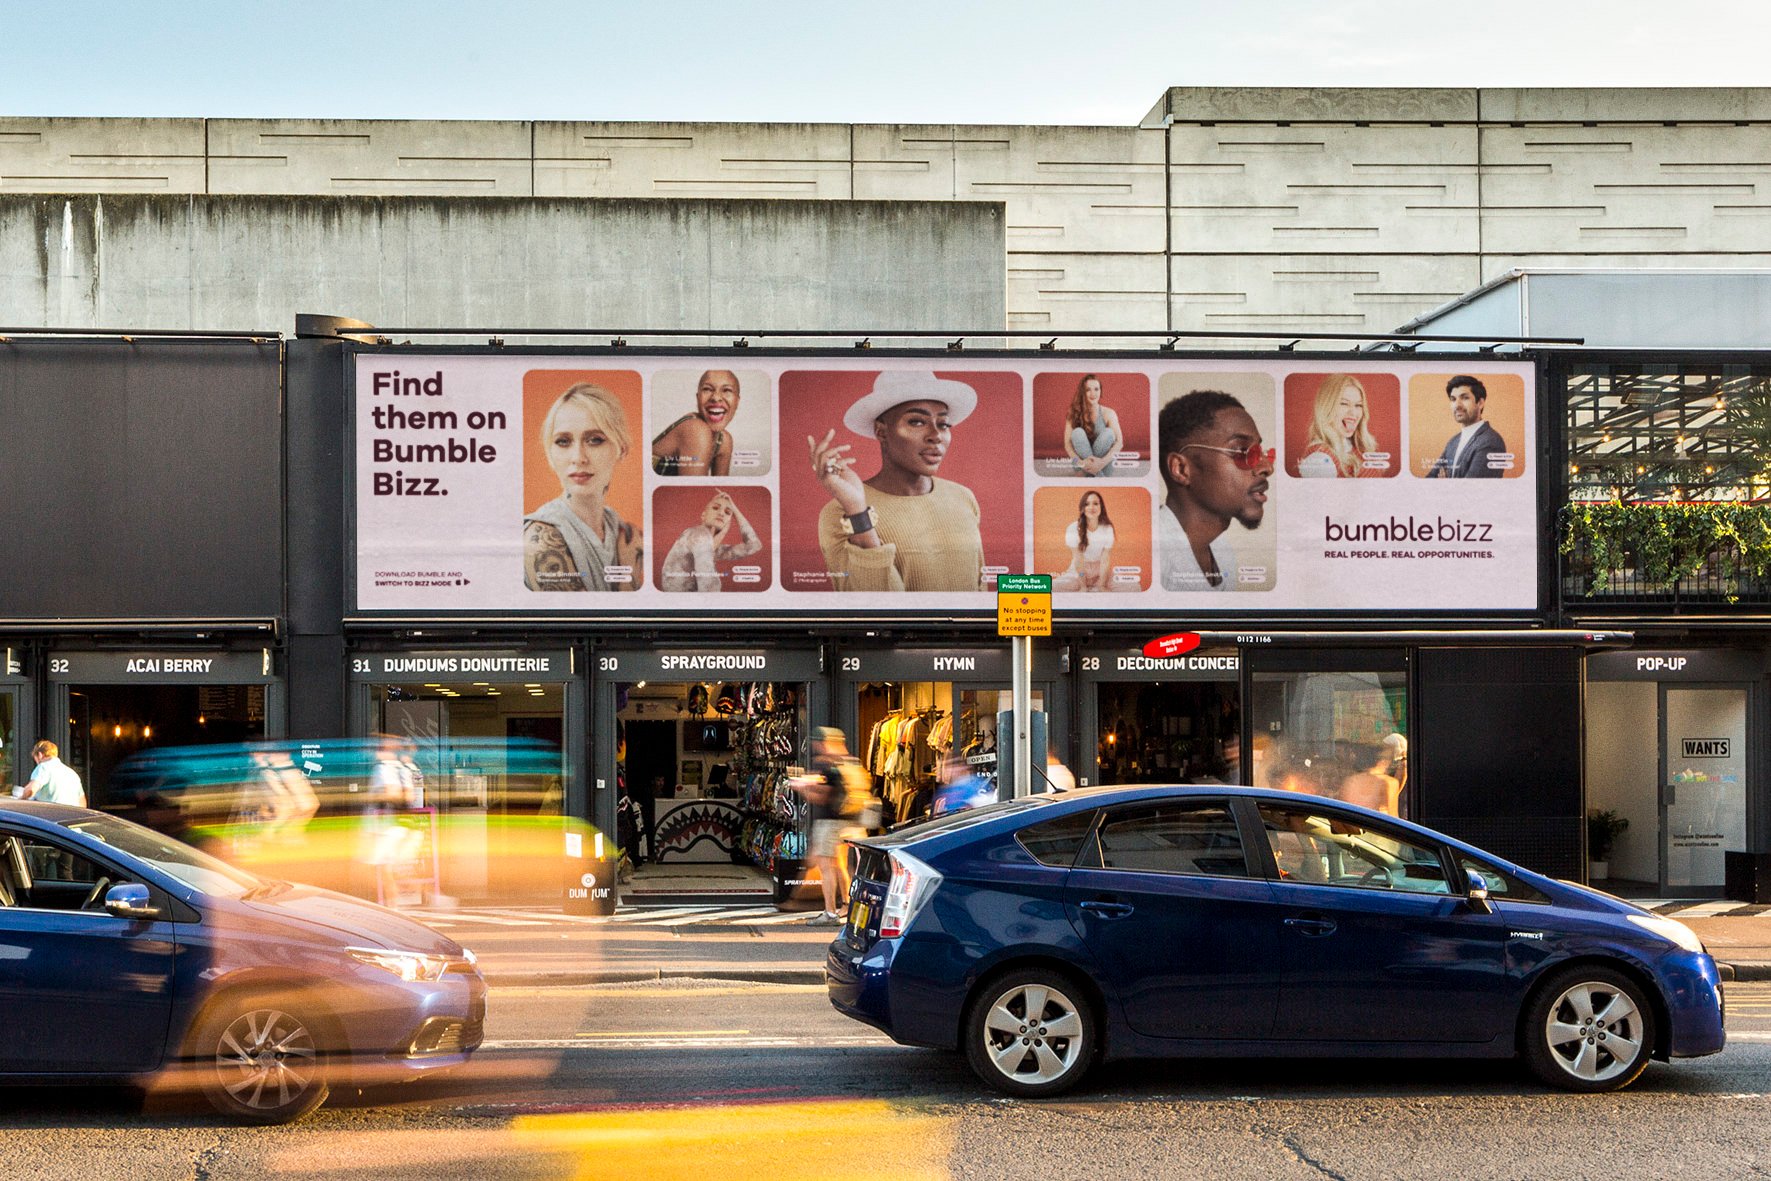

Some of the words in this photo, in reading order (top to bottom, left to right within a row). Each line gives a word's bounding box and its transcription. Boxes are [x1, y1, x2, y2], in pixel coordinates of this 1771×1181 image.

[373, 370, 443, 396] Find
[371, 404, 458, 430] them
[467, 411, 507, 430] on
[373, 437, 497, 463] Bumble
[373, 470, 449, 496] Bizz.
[1417, 551, 1495, 559] OPPORTUNITIES.
[1237, 635, 1254, 643] 0112
[1255, 635, 1271, 643] 1166
[50, 659, 69, 673] 32
[126, 659, 160, 673] ACAI
[163, 659, 213, 673] BERRY
[352, 659, 371, 672] 31
[384, 658, 458, 672] DUMDUMS
[461, 658, 550, 671] DONUTTERIE
[599, 657, 618, 671] 30
[661, 655, 766, 669] SPRAYGROUND
[842, 657, 860, 671] 29
[933, 657, 975, 671] HYMN
[1081, 657, 1100, 671] 28
[1117, 656, 1185, 670] DECORUM
[1636, 657, 1687, 671] POP-UP
[1684, 741, 1728, 755] WANTS
[971, 755, 991, 763] OPEN
[569, 888, 587, 898] DUM
